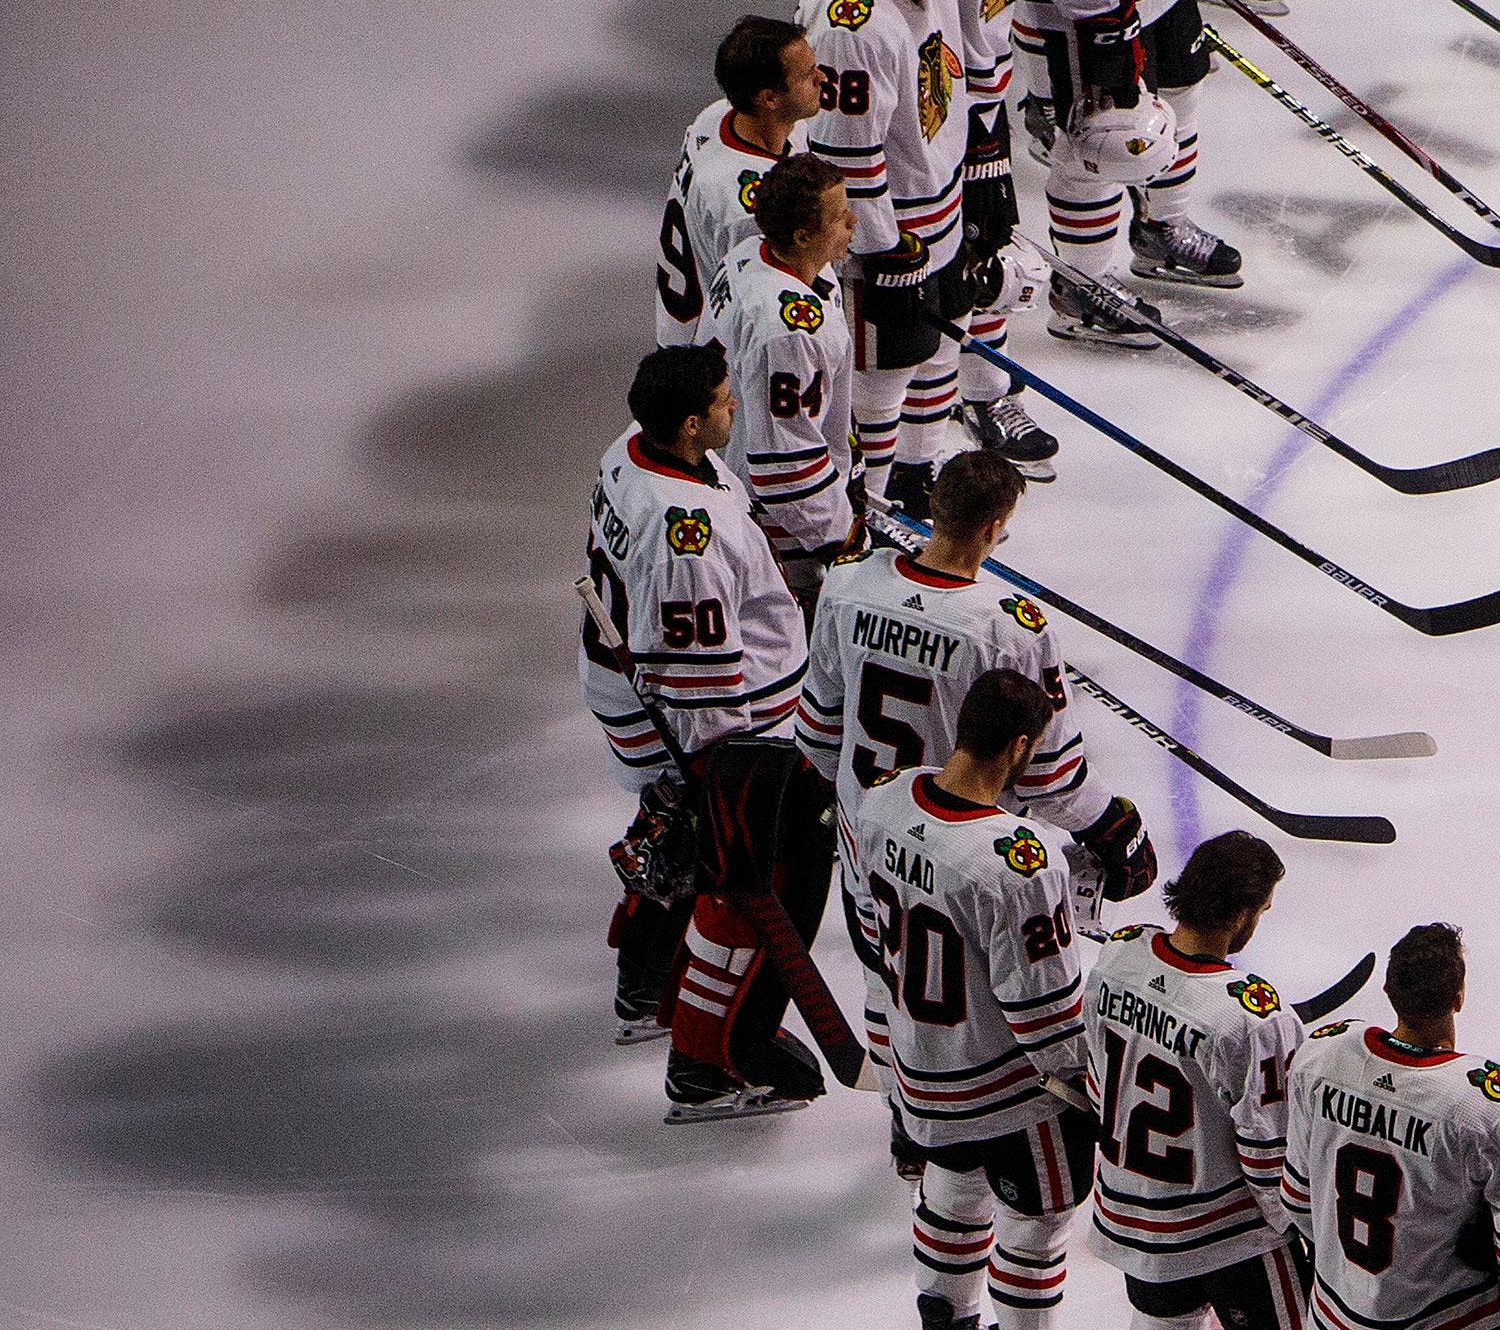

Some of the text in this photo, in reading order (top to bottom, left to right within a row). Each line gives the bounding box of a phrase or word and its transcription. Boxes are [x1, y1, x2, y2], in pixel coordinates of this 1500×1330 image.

[1277, 37, 1371, 118] JETSPEED
[768, 369, 826, 420] 64
[1211, 357, 1331, 445] TRUE
[660, 598, 727, 649] 50
[851, 608, 961, 674] MURPHY
[851, 660, 935, 789] 5
[884, 836, 936, 897] SAAD
[868, 869, 968, 1029] 20
[1020, 901, 1074, 965] 20
[1099, 1024, 1196, 1186] 12
[1320, 1084, 1433, 1158] KUBALIK
[1335, 1141, 1404, 1277] 8
